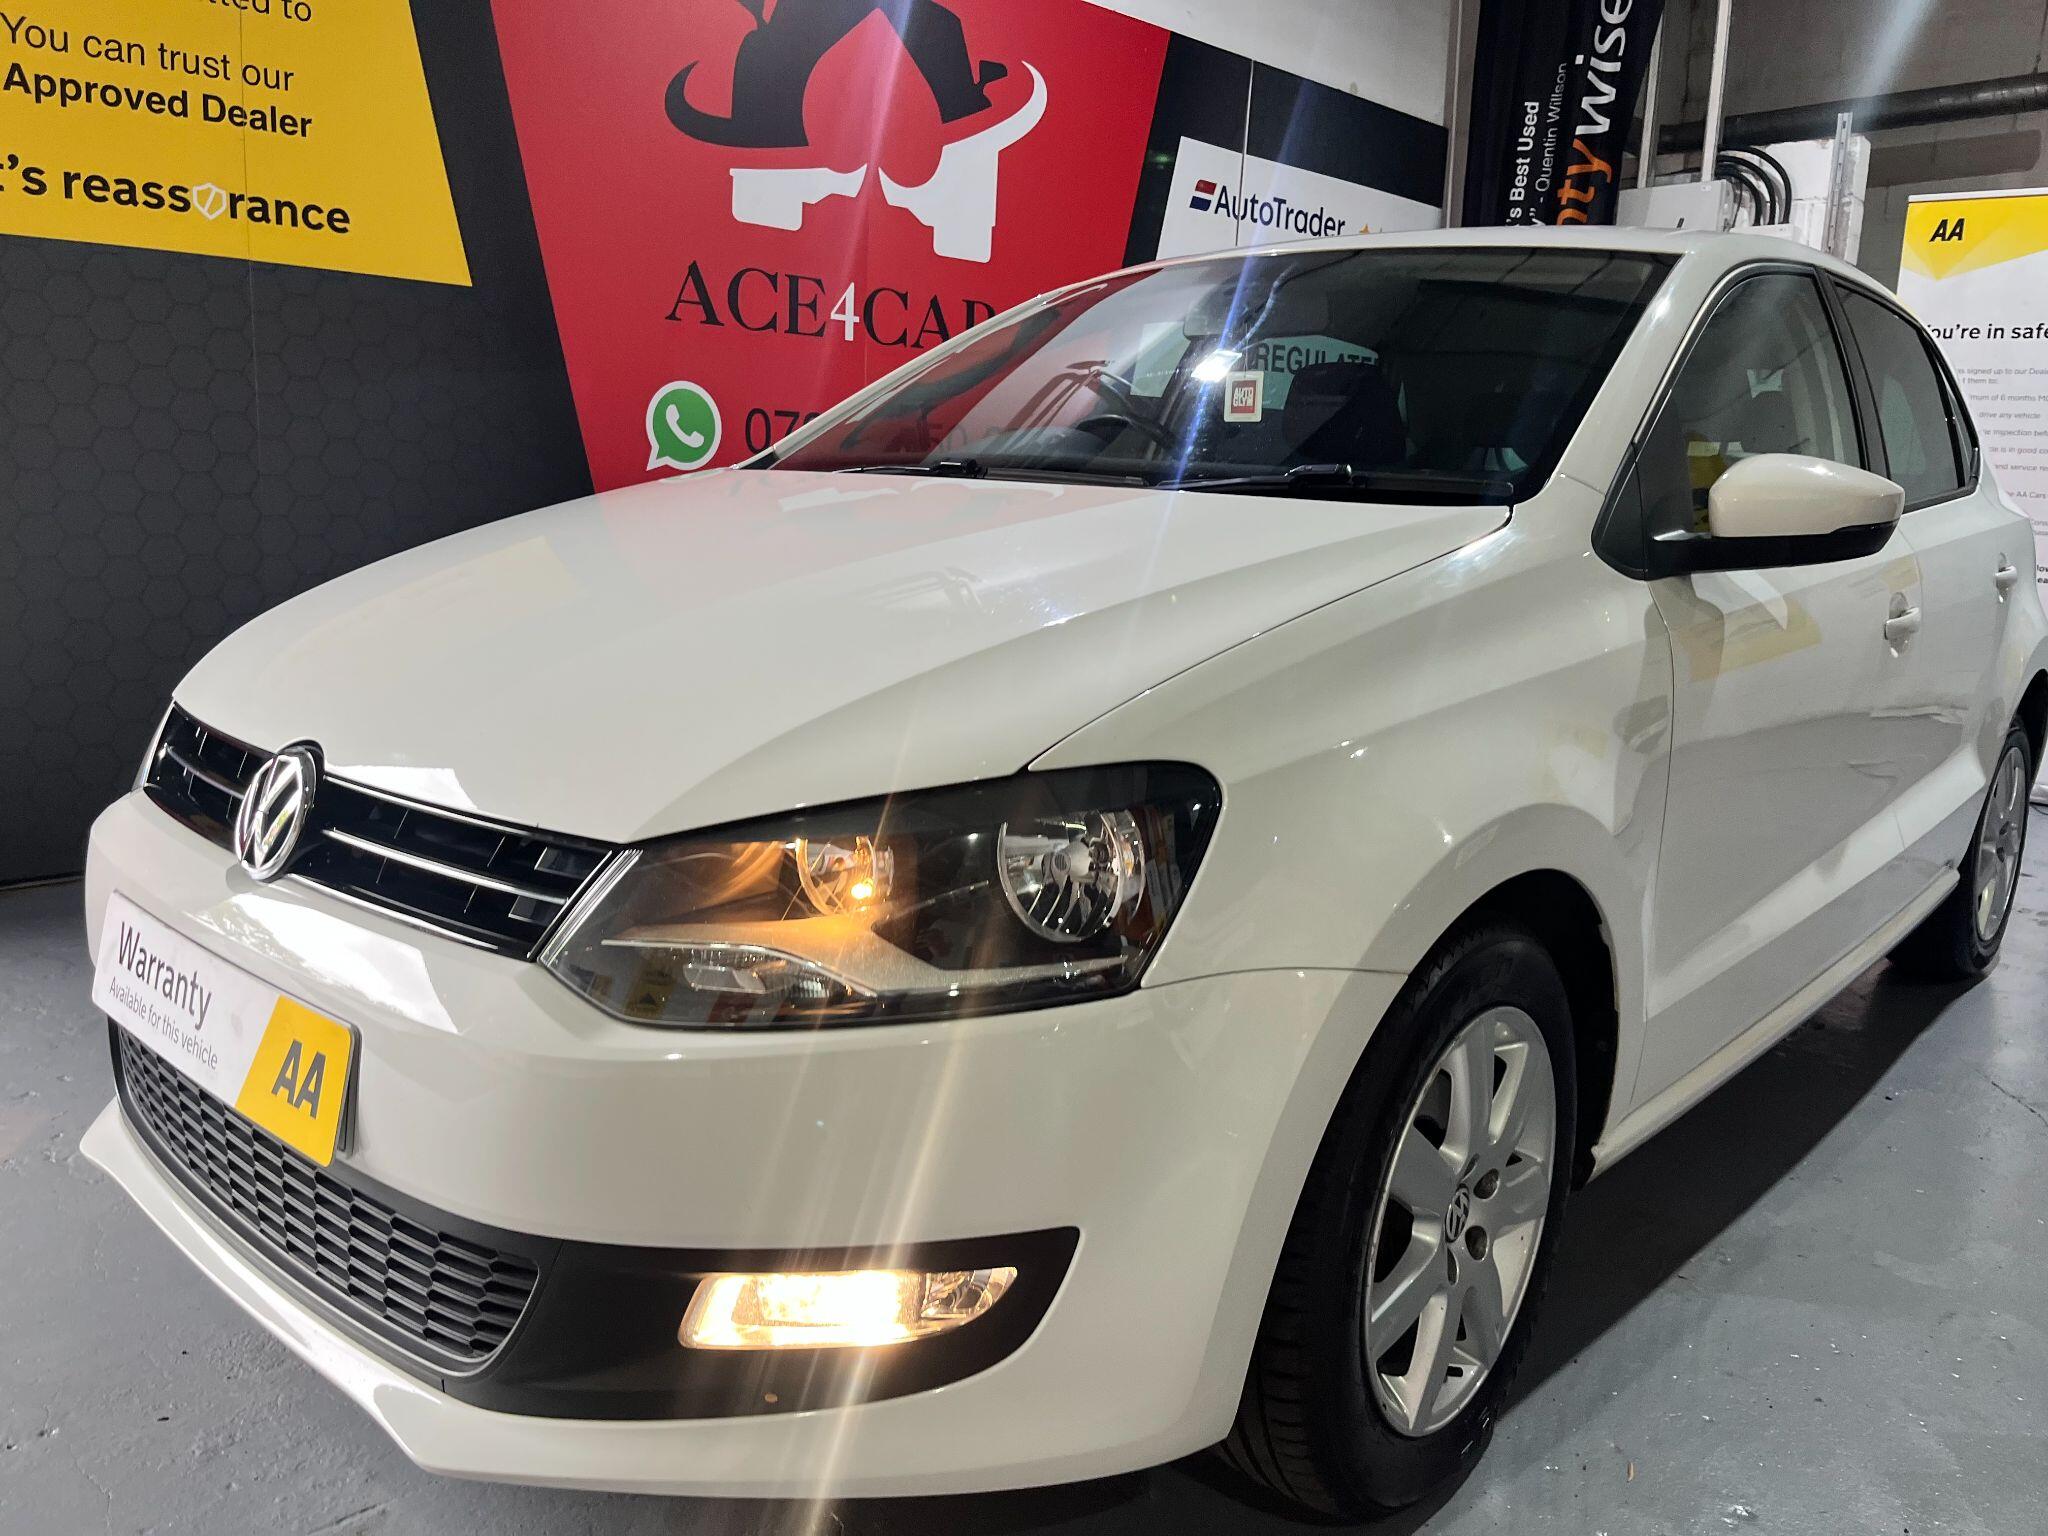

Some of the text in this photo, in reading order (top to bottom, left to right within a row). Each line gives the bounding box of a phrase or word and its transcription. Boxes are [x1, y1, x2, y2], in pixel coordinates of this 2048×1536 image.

[0, 13, 294, 91] You can trust our
[3, 62, 313, 138] Approved Dealer
[1546, 62, 1568, 123] Willson
[1516, 101, 1540, 151] Used
[0, 153, 48, 196] 's
[1510, 157, 1531, 201] Best
[1535, 127, 1559, 192] Quentin
[1214, 185, 1346, 238] AutoTrader
[1929, 218, 1966, 243] AA
[1927, 323, 1981, 339] ou're
[1987, 323, 2005, 339] in
[117, 920, 212, 1031] Warranty
[109, 975, 218, 1071] Available for this vehicle
[271, 1038, 327, 1121] AA
